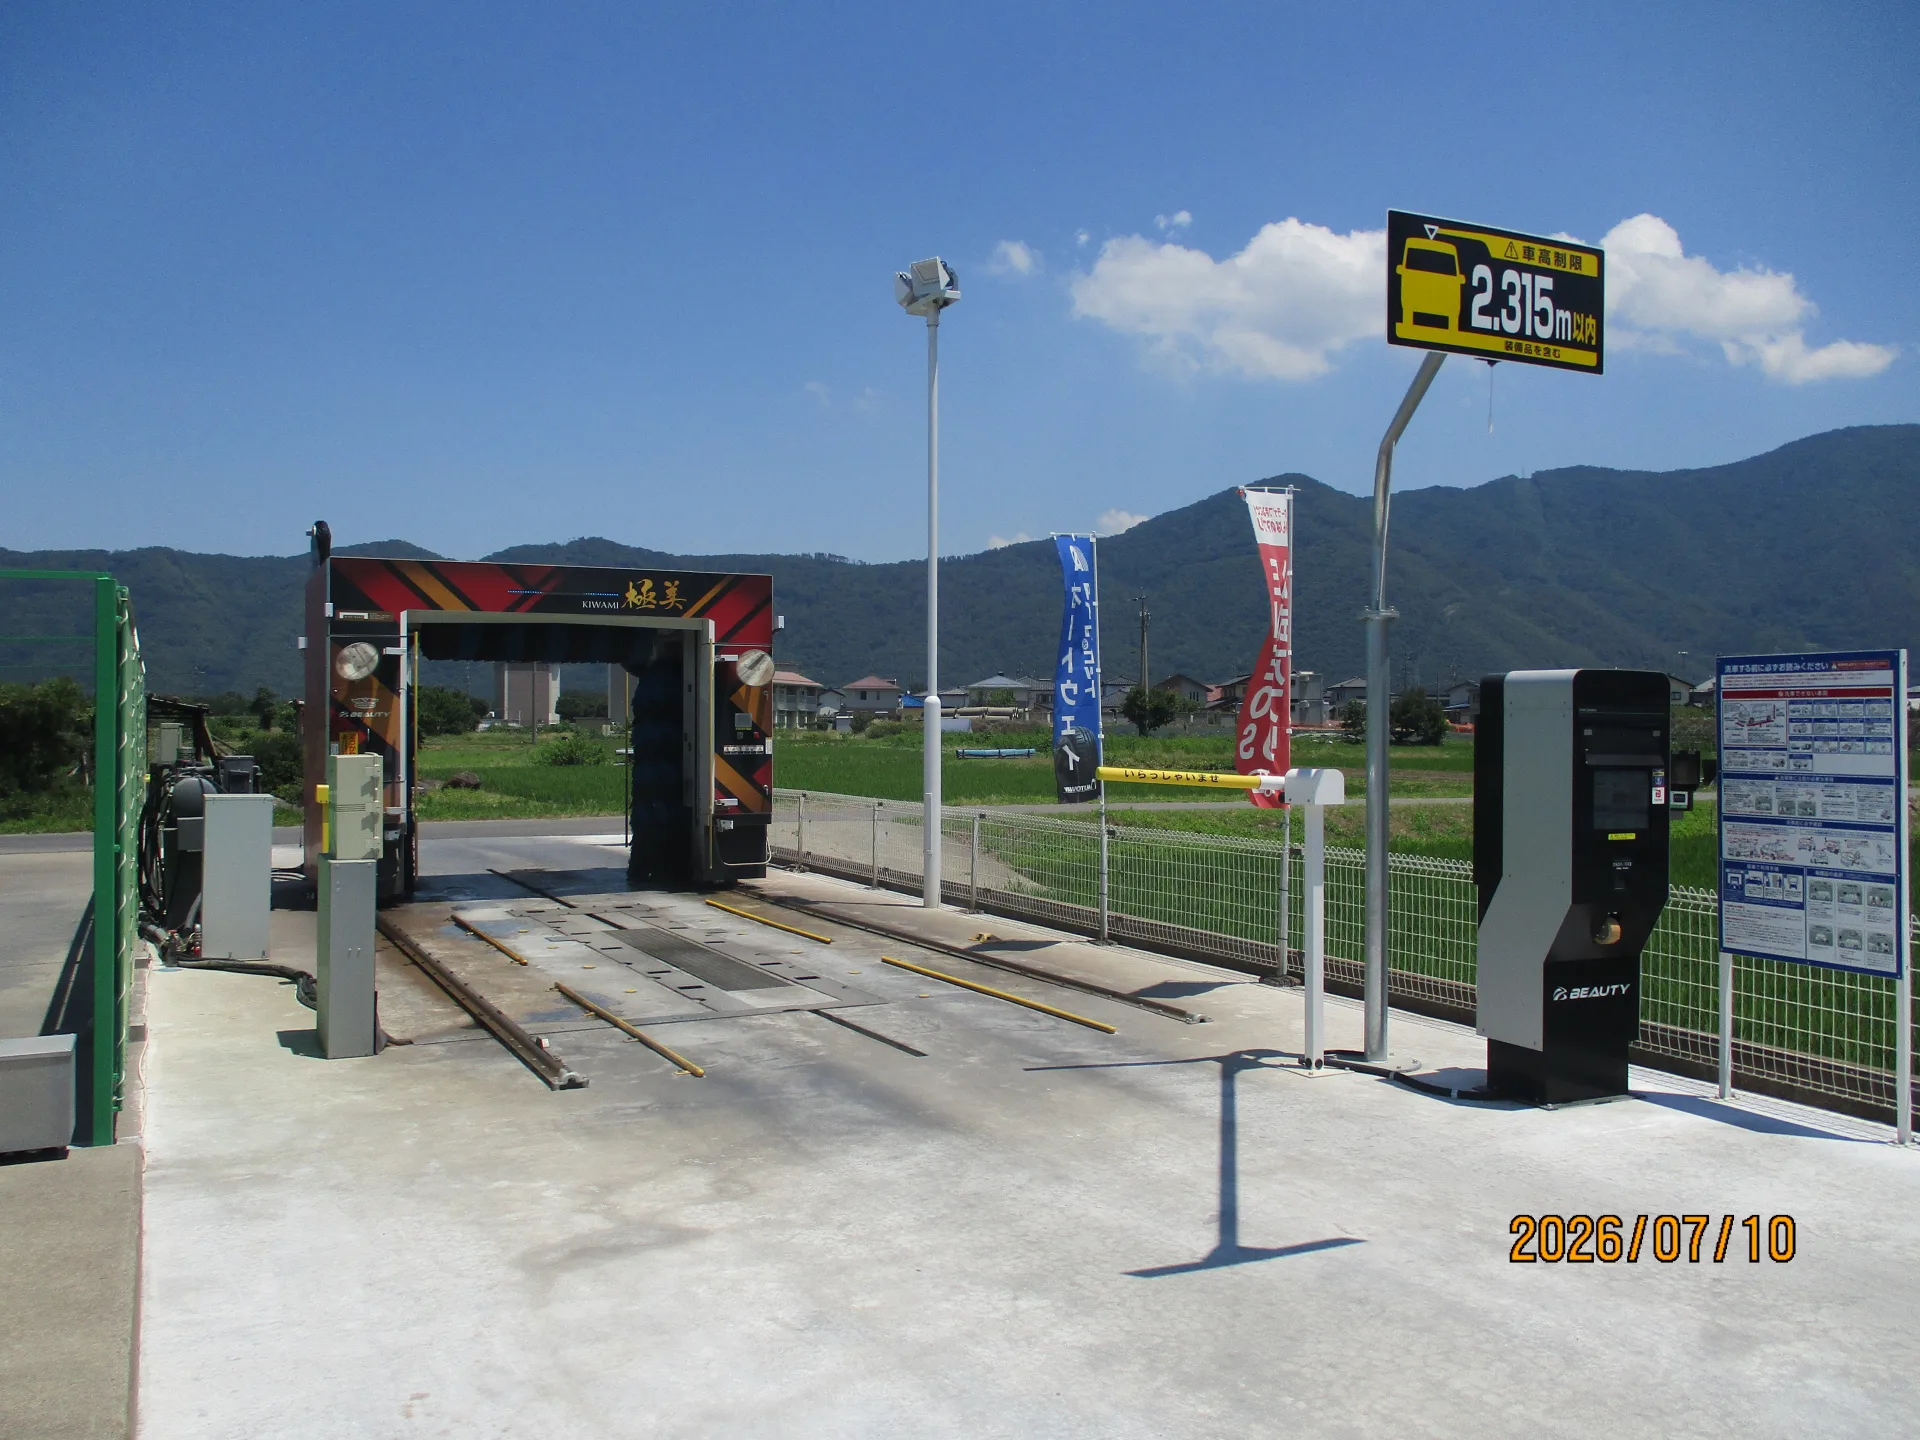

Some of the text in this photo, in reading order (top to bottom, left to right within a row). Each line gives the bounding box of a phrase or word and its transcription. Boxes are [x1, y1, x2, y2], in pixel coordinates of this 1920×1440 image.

[1522, 245, 1582, 271] 車高制限
[1504, 340, 1561, 359] 装備品を含む
[582, 578, 687, 610] KIWAMI 極美
[1124, 769, 1220, 783] いらっしゃいませ
[1569, 983, 1631, 1000] BEAUTY
